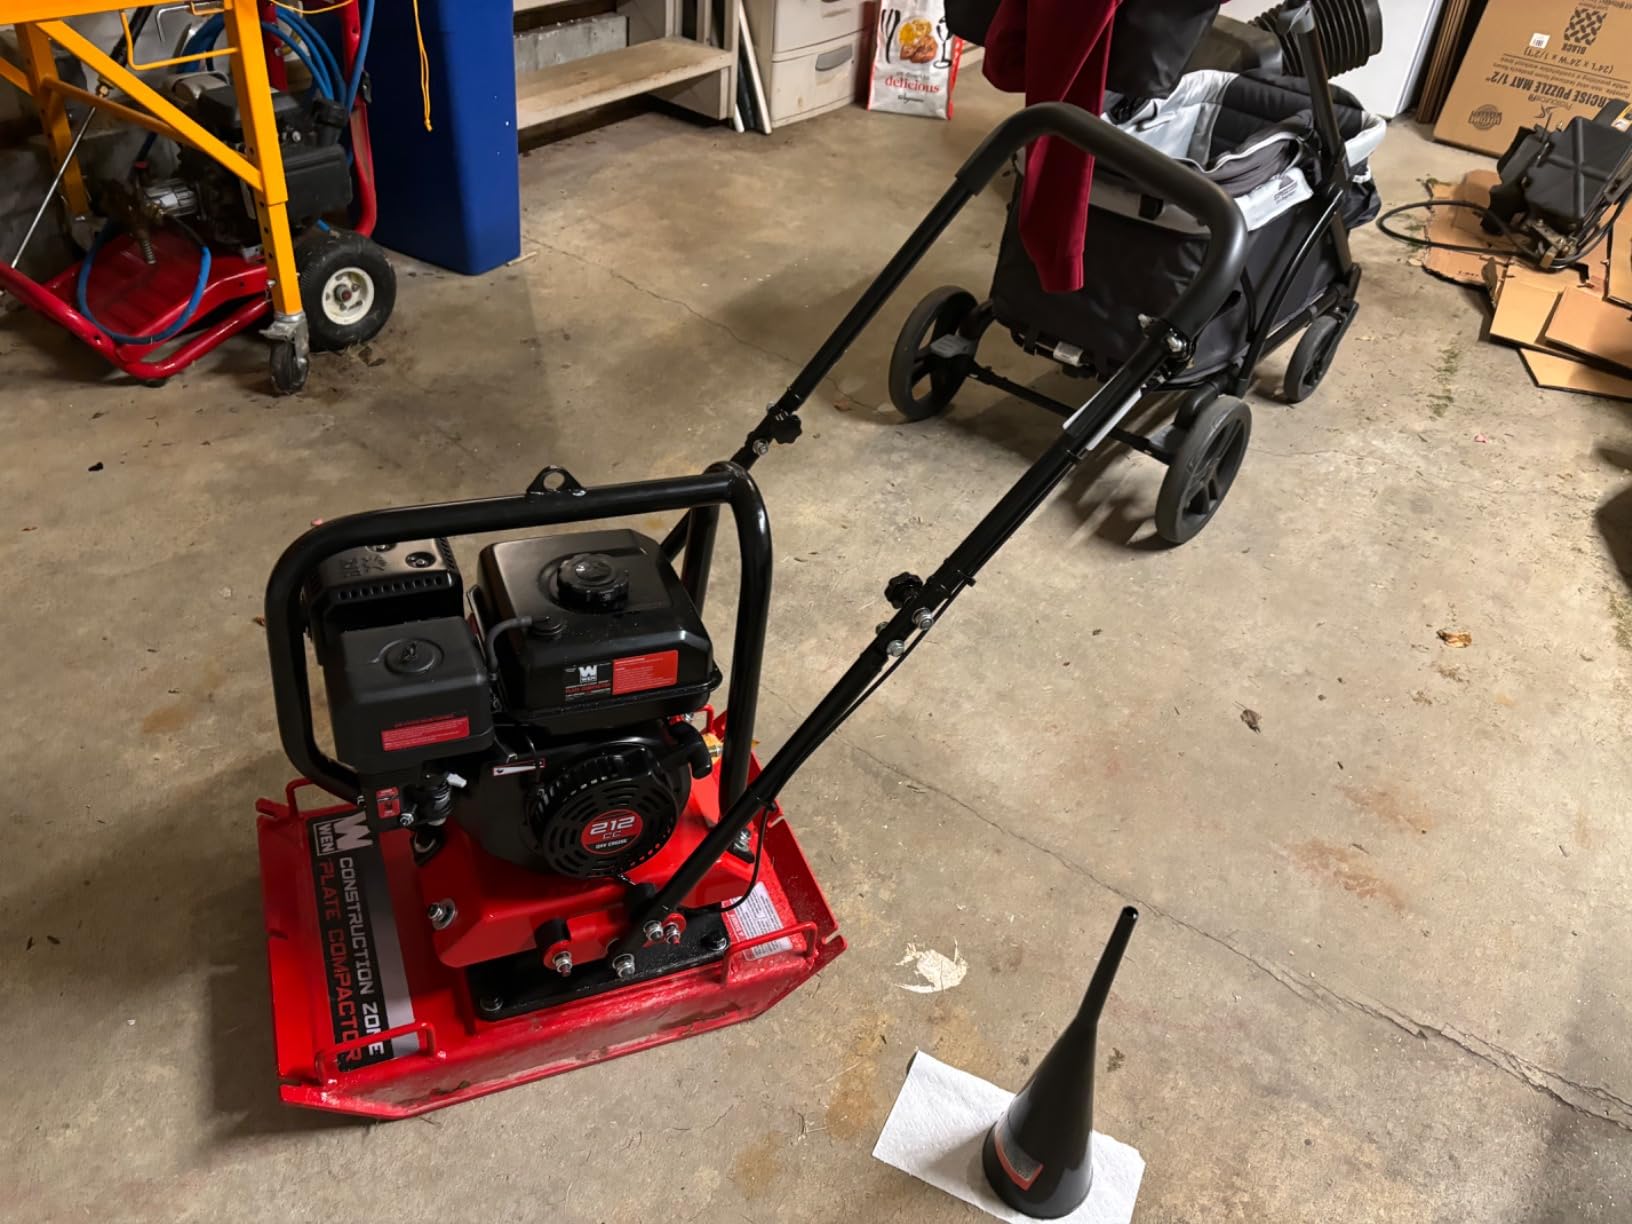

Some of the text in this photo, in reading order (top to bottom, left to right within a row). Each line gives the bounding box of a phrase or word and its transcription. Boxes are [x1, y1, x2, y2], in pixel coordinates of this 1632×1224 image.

[1561, 43, 1586, 54] BLACK
[885, 75, 940, 93] delicious
[1509, 76, 1534, 92] MAT
[1533, 81, 1572, 100] PUZZLE
[1572, 90, 1608, 108] RCISE
[590, 816, 635, 836] 212
[318, 823, 336, 853] WEN
[340, 857, 374, 995] CONSTRUCTION
[319, 861, 362, 1062] PLATE COMPACTOR
